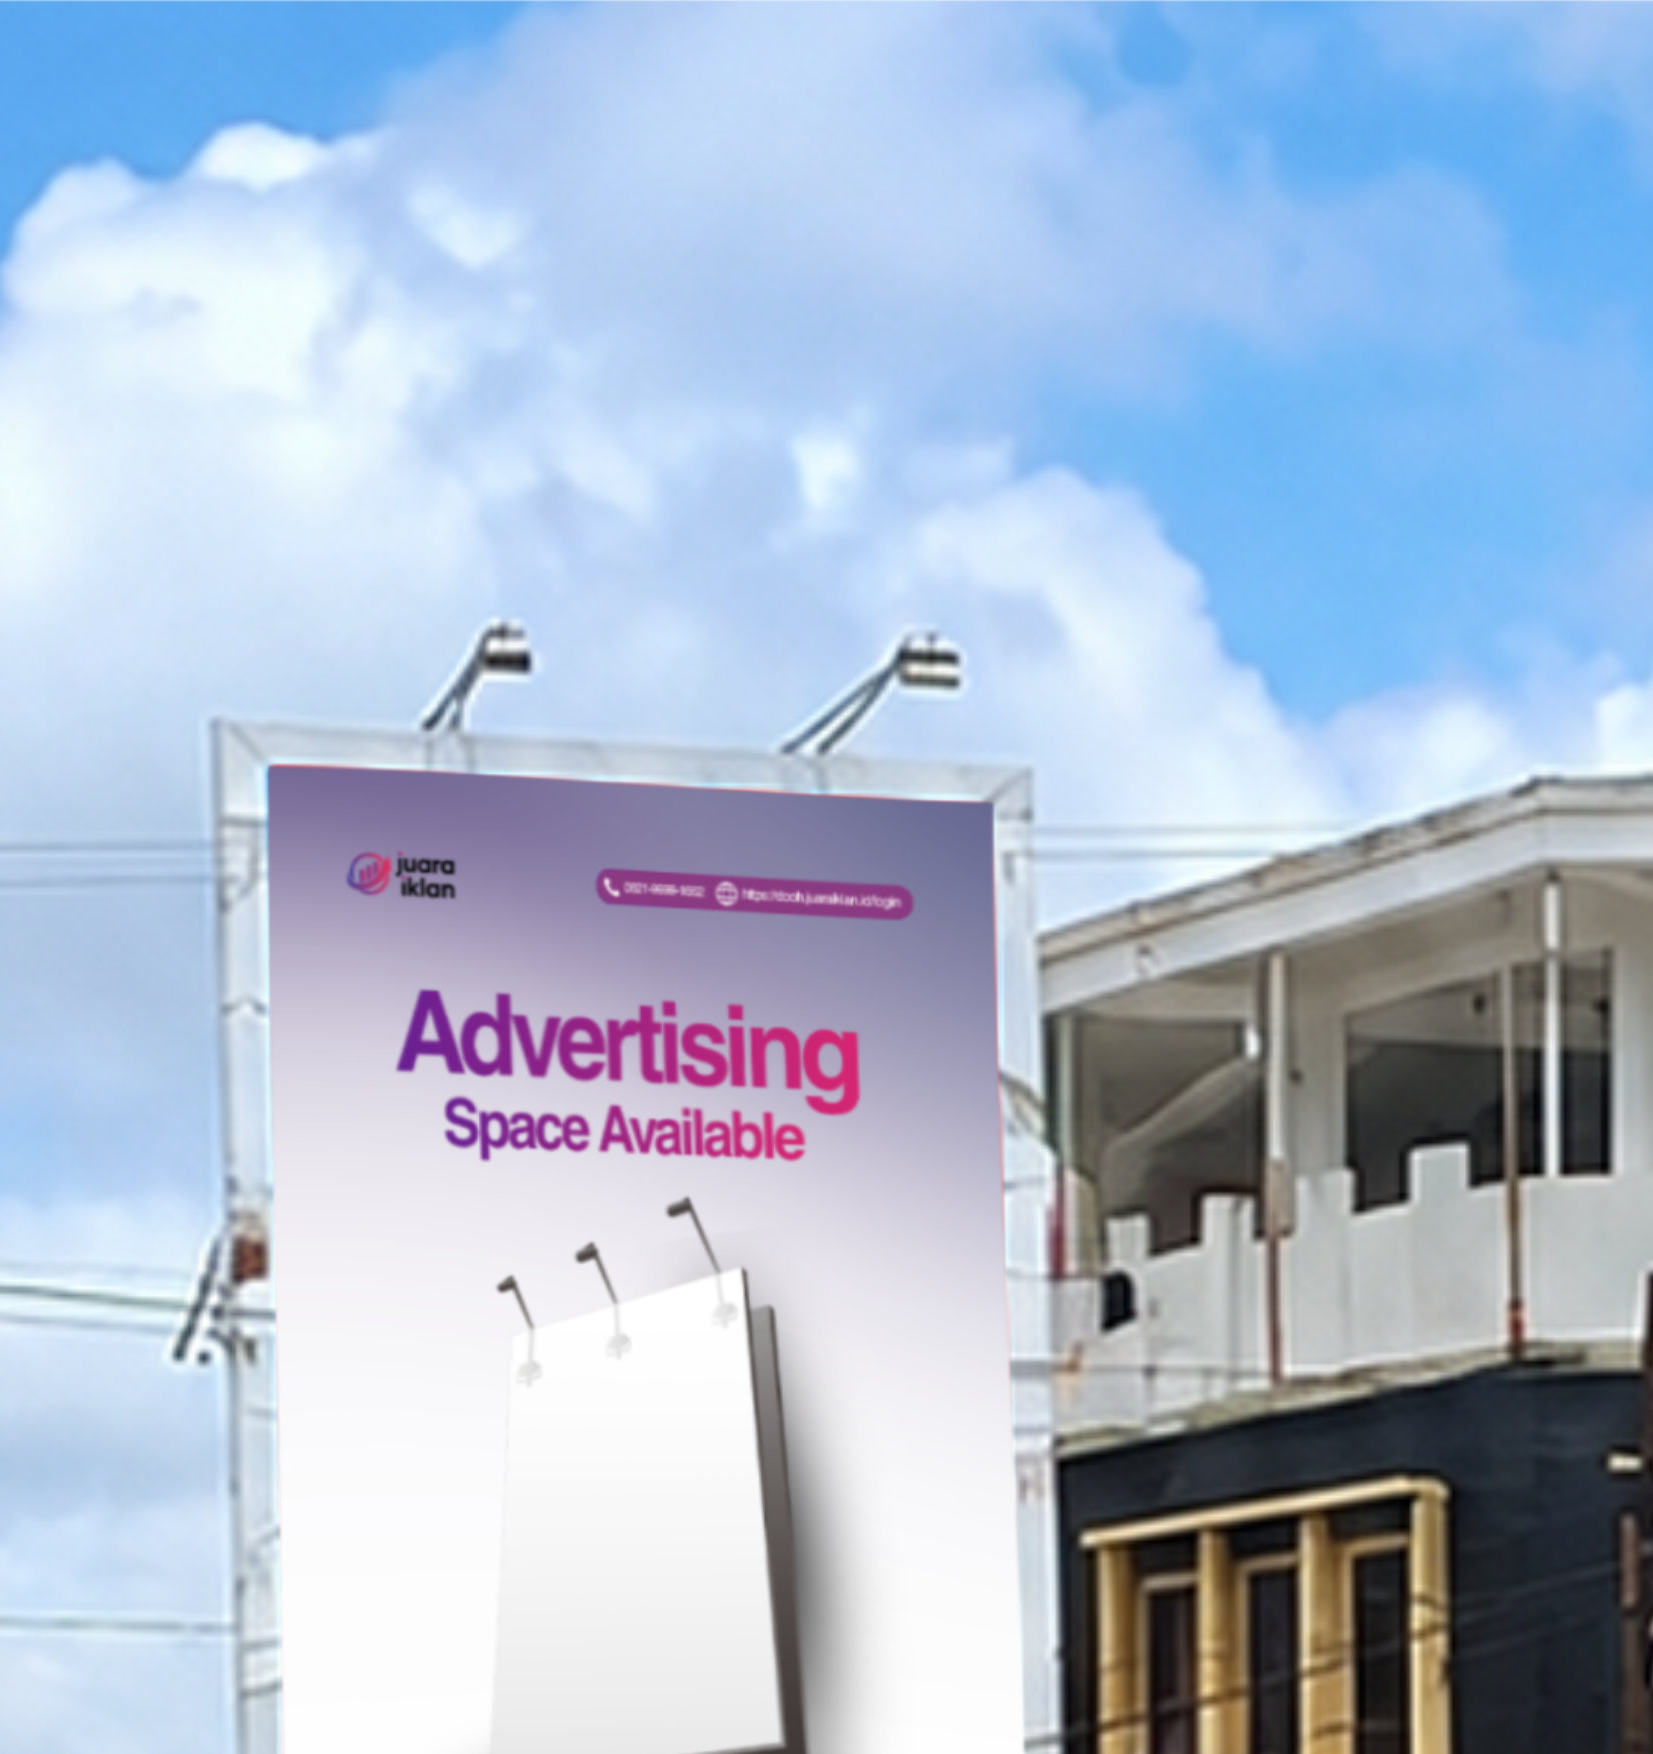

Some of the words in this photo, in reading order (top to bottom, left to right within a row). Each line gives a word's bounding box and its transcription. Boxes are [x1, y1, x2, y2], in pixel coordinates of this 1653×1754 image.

[396, 850, 455, 877] juara
[400, 874, 456, 899] iklan
[397, 989, 861, 1115] Advertising
[444, 1096, 590, 1160] Space
[599, 1104, 806, 1161] Available
